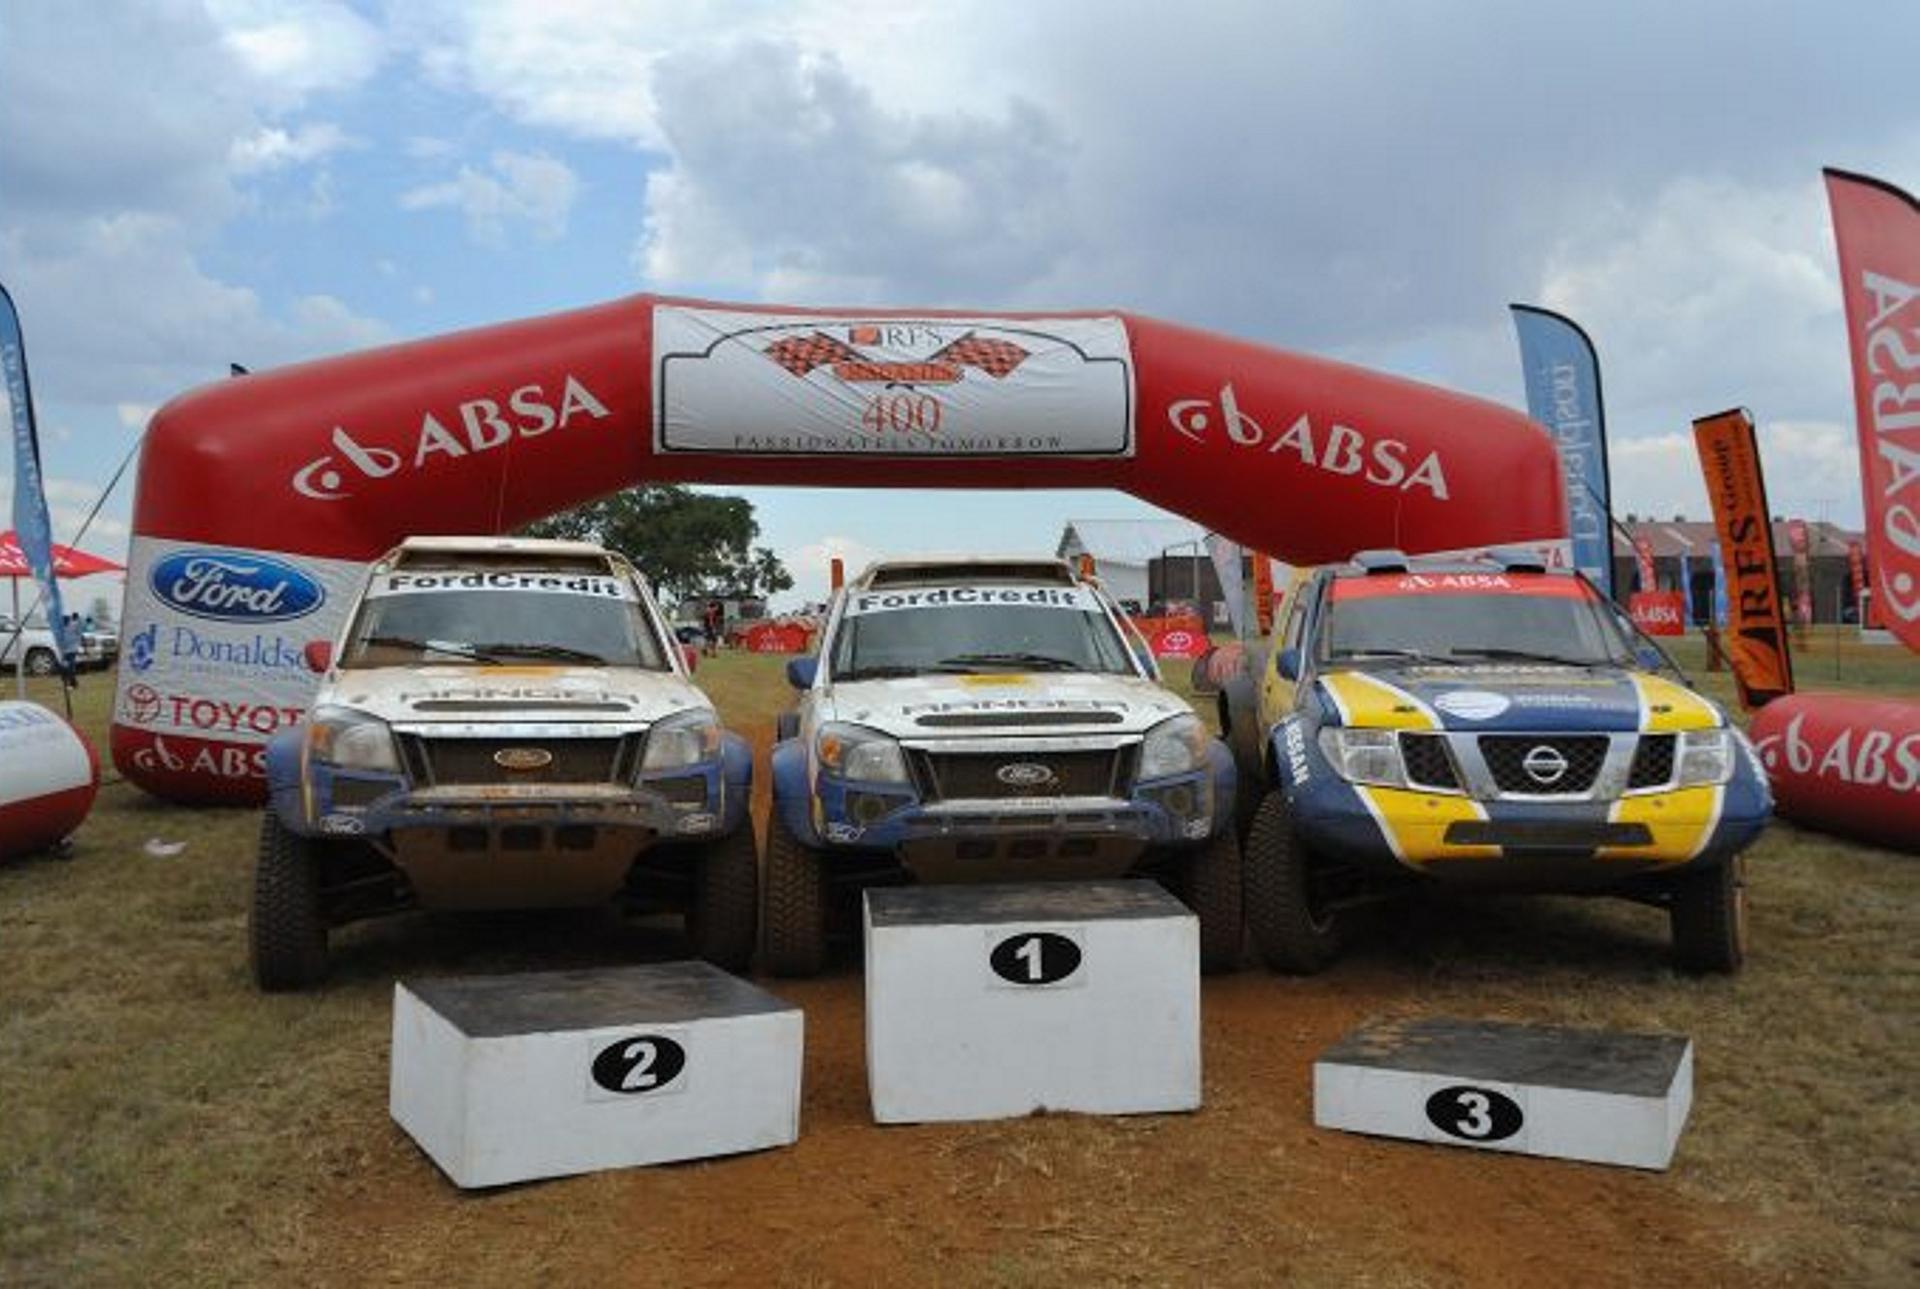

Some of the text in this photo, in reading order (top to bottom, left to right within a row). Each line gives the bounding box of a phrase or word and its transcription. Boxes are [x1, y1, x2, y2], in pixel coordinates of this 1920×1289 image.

[415, 375, 609, 466] ABSA
[862, 394, 941, 434] 400
[1270, 414, 1449, 501] ABSA
[172, 558, 289, 614] Ford
[388, 572, 621, 597] FordCredit
[1729, 515, 1775, 623] RFS
[859, 588, 1076, 611] FordCredit
[168, 696, 305, 733] TOYOT
[192, 747, 267, 776] ABS
[1818, 725, 1920, 791] ABS
[1016, 938, 1042, 980] 1
[621, 1042, 657, 1089] 2
[1457, 1092, 1493, 1136] 3
